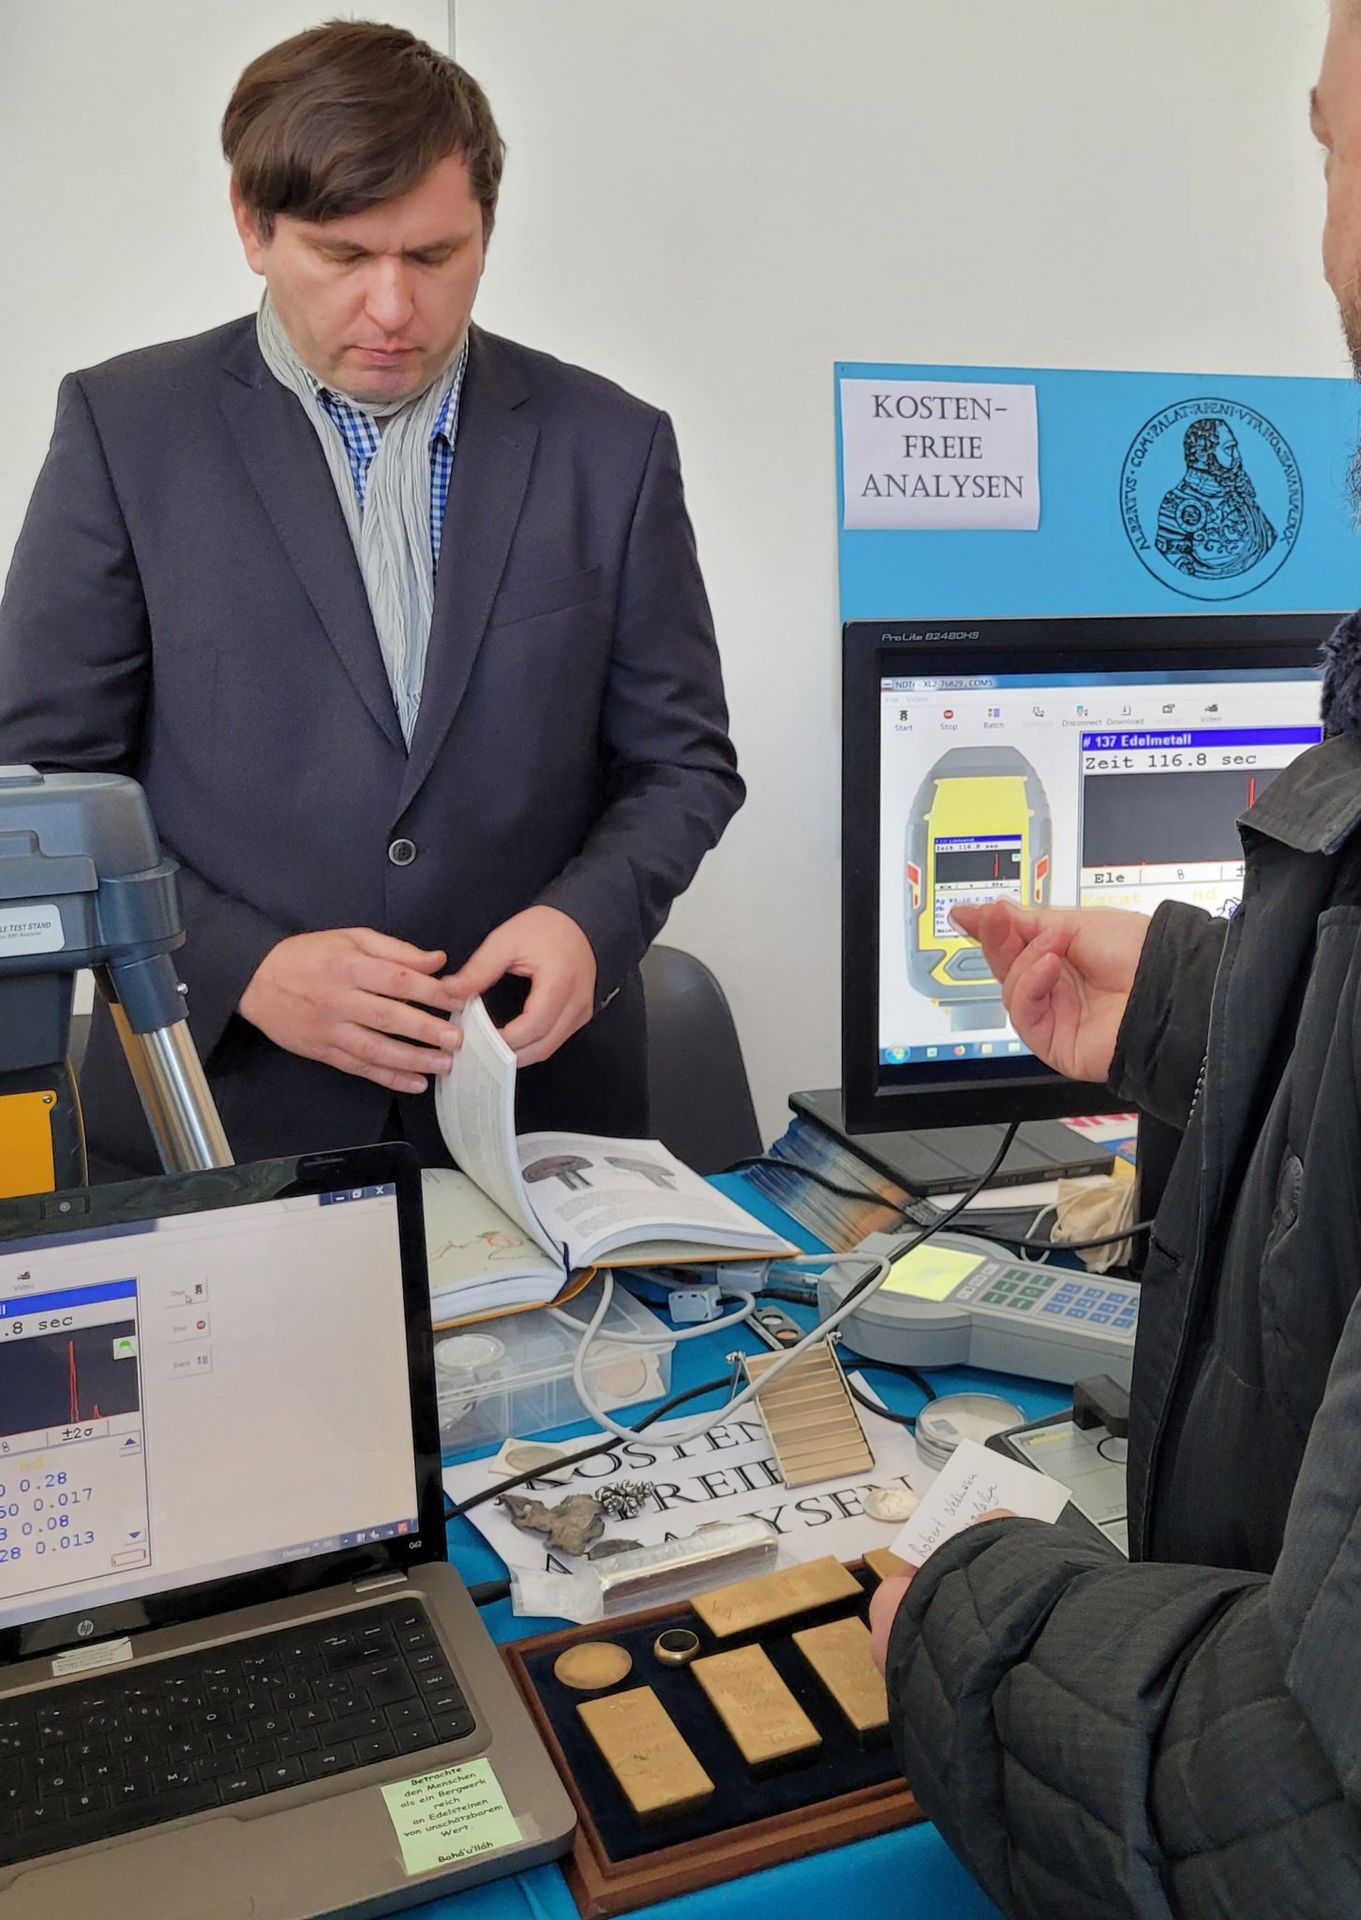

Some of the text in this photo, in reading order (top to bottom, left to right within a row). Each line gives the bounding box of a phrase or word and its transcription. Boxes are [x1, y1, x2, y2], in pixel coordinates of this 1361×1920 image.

[872, 395, 1008, 421] KOSTEN-
[903, 435, 983, 460] FREIE
[861, 473, 1025, 498] ANALYSEN
[895, 724, 913, 733] Start
[941, 723, 958, 732] Stop
[1083, 733, 1192, 748] # 137 Edelmetall
[1085, 753, 1258, 770] Zeit 116.8 sec
[1094, 872, 1126, 884] Ele
[28, 921, 51, 931] STAND
[38, 1315, 74, 1332] sec
[20, 1472, 68, 1493] 0.28
[607, 1457, 785, 1523] REIE
[34, 1487, 93, 1512] 0.017
[22, 1514, 70, 1536] 0.08
[36, 1530, 95, 1555] 0.013
[77, 1619, 94, 1637] hp
[404, 1772, 476, 1798] den Menschen
[411, 1767, 462, 1786] Betrachte
[400, 1778, 487, 1808] als ein Bergwerk
[433, 1797, 461, 1810] reich
[429, 1798, 489, 1820] Edelsteinen
[404, 1805, 504, 1838] von unschätzbarem
